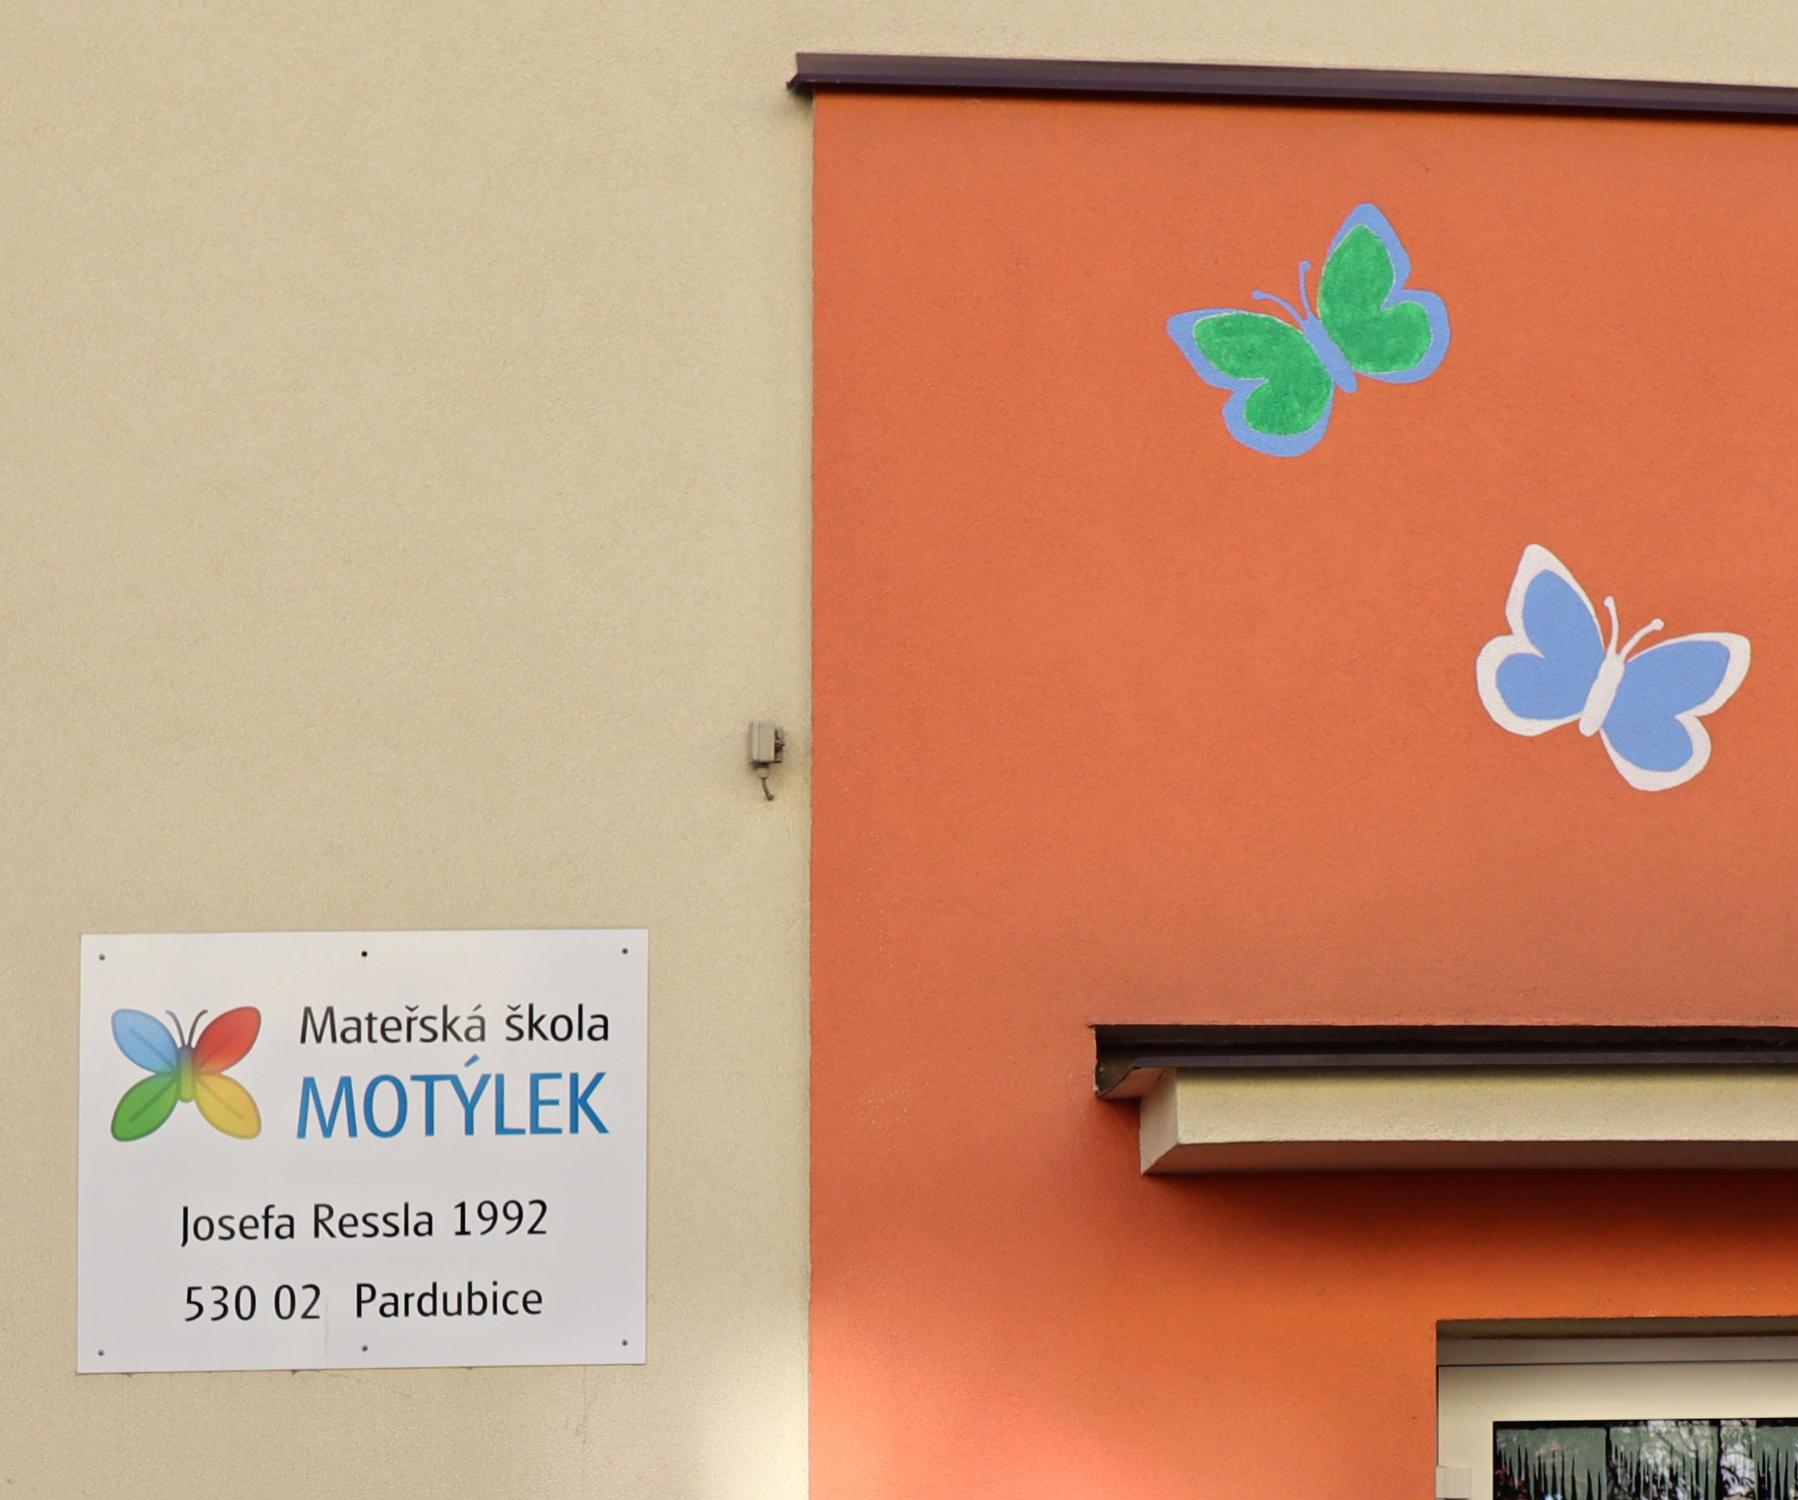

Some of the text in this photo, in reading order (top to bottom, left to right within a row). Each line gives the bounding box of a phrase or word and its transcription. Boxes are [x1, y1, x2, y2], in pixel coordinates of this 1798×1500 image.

[300, 1003, 608, 1044] Mateřská škola
[297, 1055, 608, 1139] MOTÝLEK
[181, 1200, 547, 1247] Josefa Ressla 1992
[185, 1281, 542, 1321] 530 02 Pardubice
